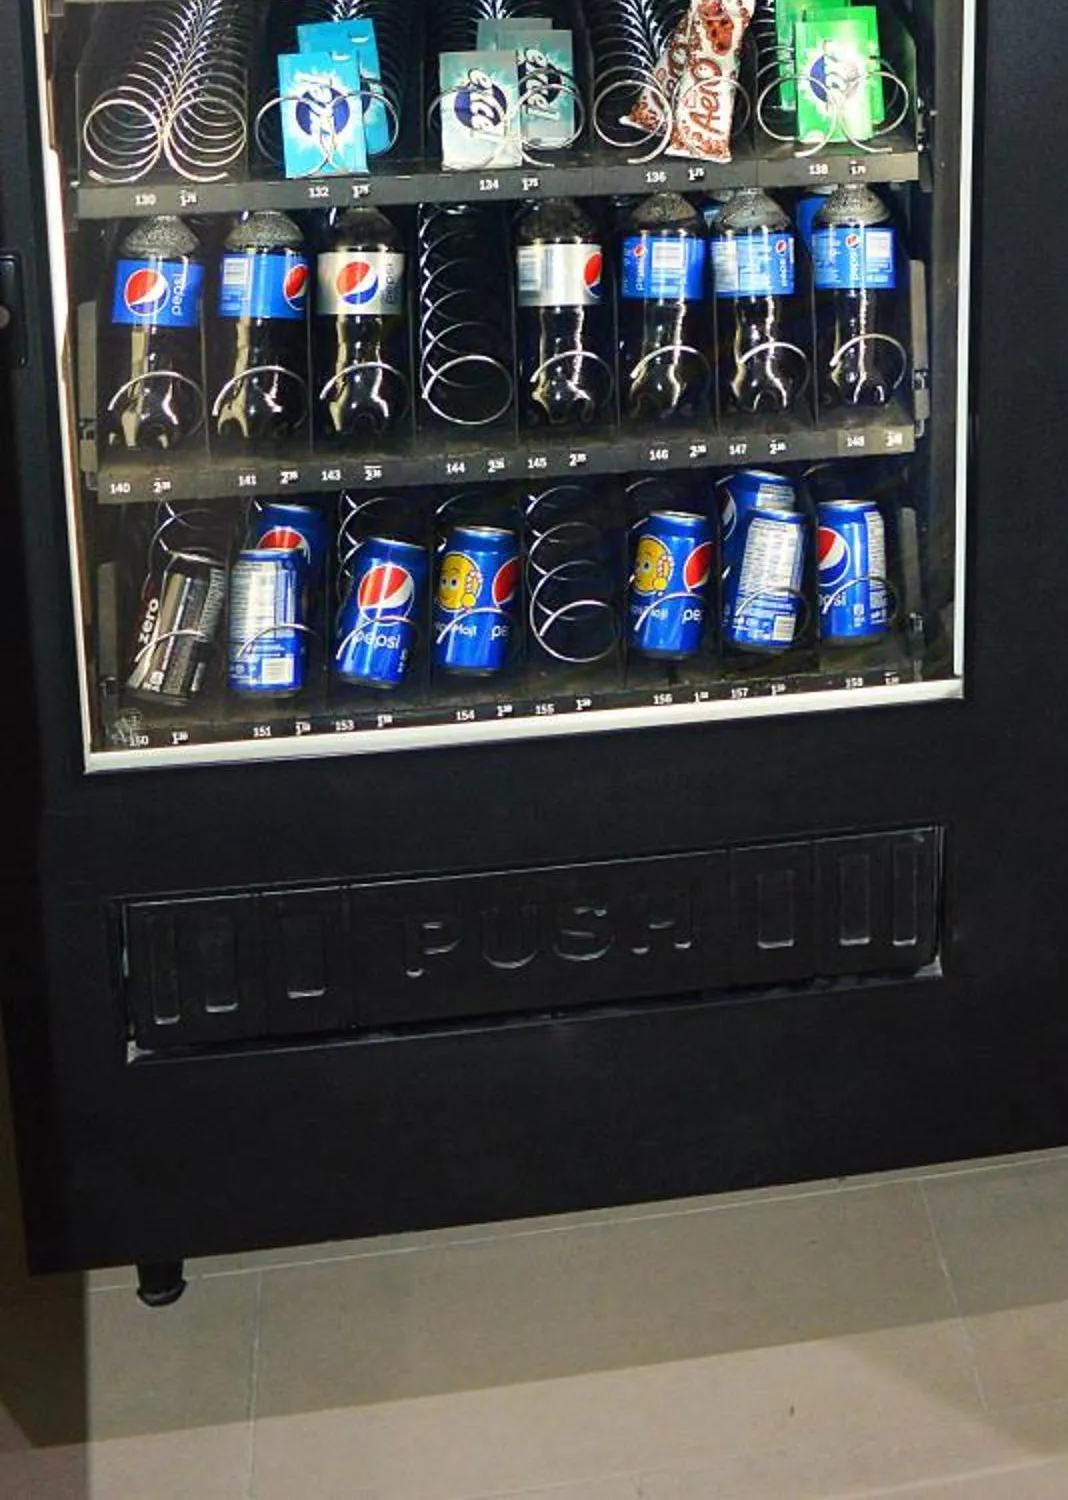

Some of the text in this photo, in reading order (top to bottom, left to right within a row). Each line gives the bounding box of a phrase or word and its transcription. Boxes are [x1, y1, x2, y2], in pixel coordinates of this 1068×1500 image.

[480, 179, 499, 191] 134
[309, 186, 329, 197] 132
[171, 273, 185, 317] pepsi
[649, 450, 668, 460] 146
[729, 444, 747, 455] 147
[446, 463, 465, 474] 144
[528, 457, 547, 469] 145
[322, 470, 341, 481] 143
[138, 598, 159, 646] zero
[354, 630, 400, 653] pepsi
[536, 704, 554, 715] 155
[456, 710, 475, 721] 154
[335, 720, 354, 731] 153
[253, 726, 272, 737] 151
[404, 889, 694, 980] PUSH
